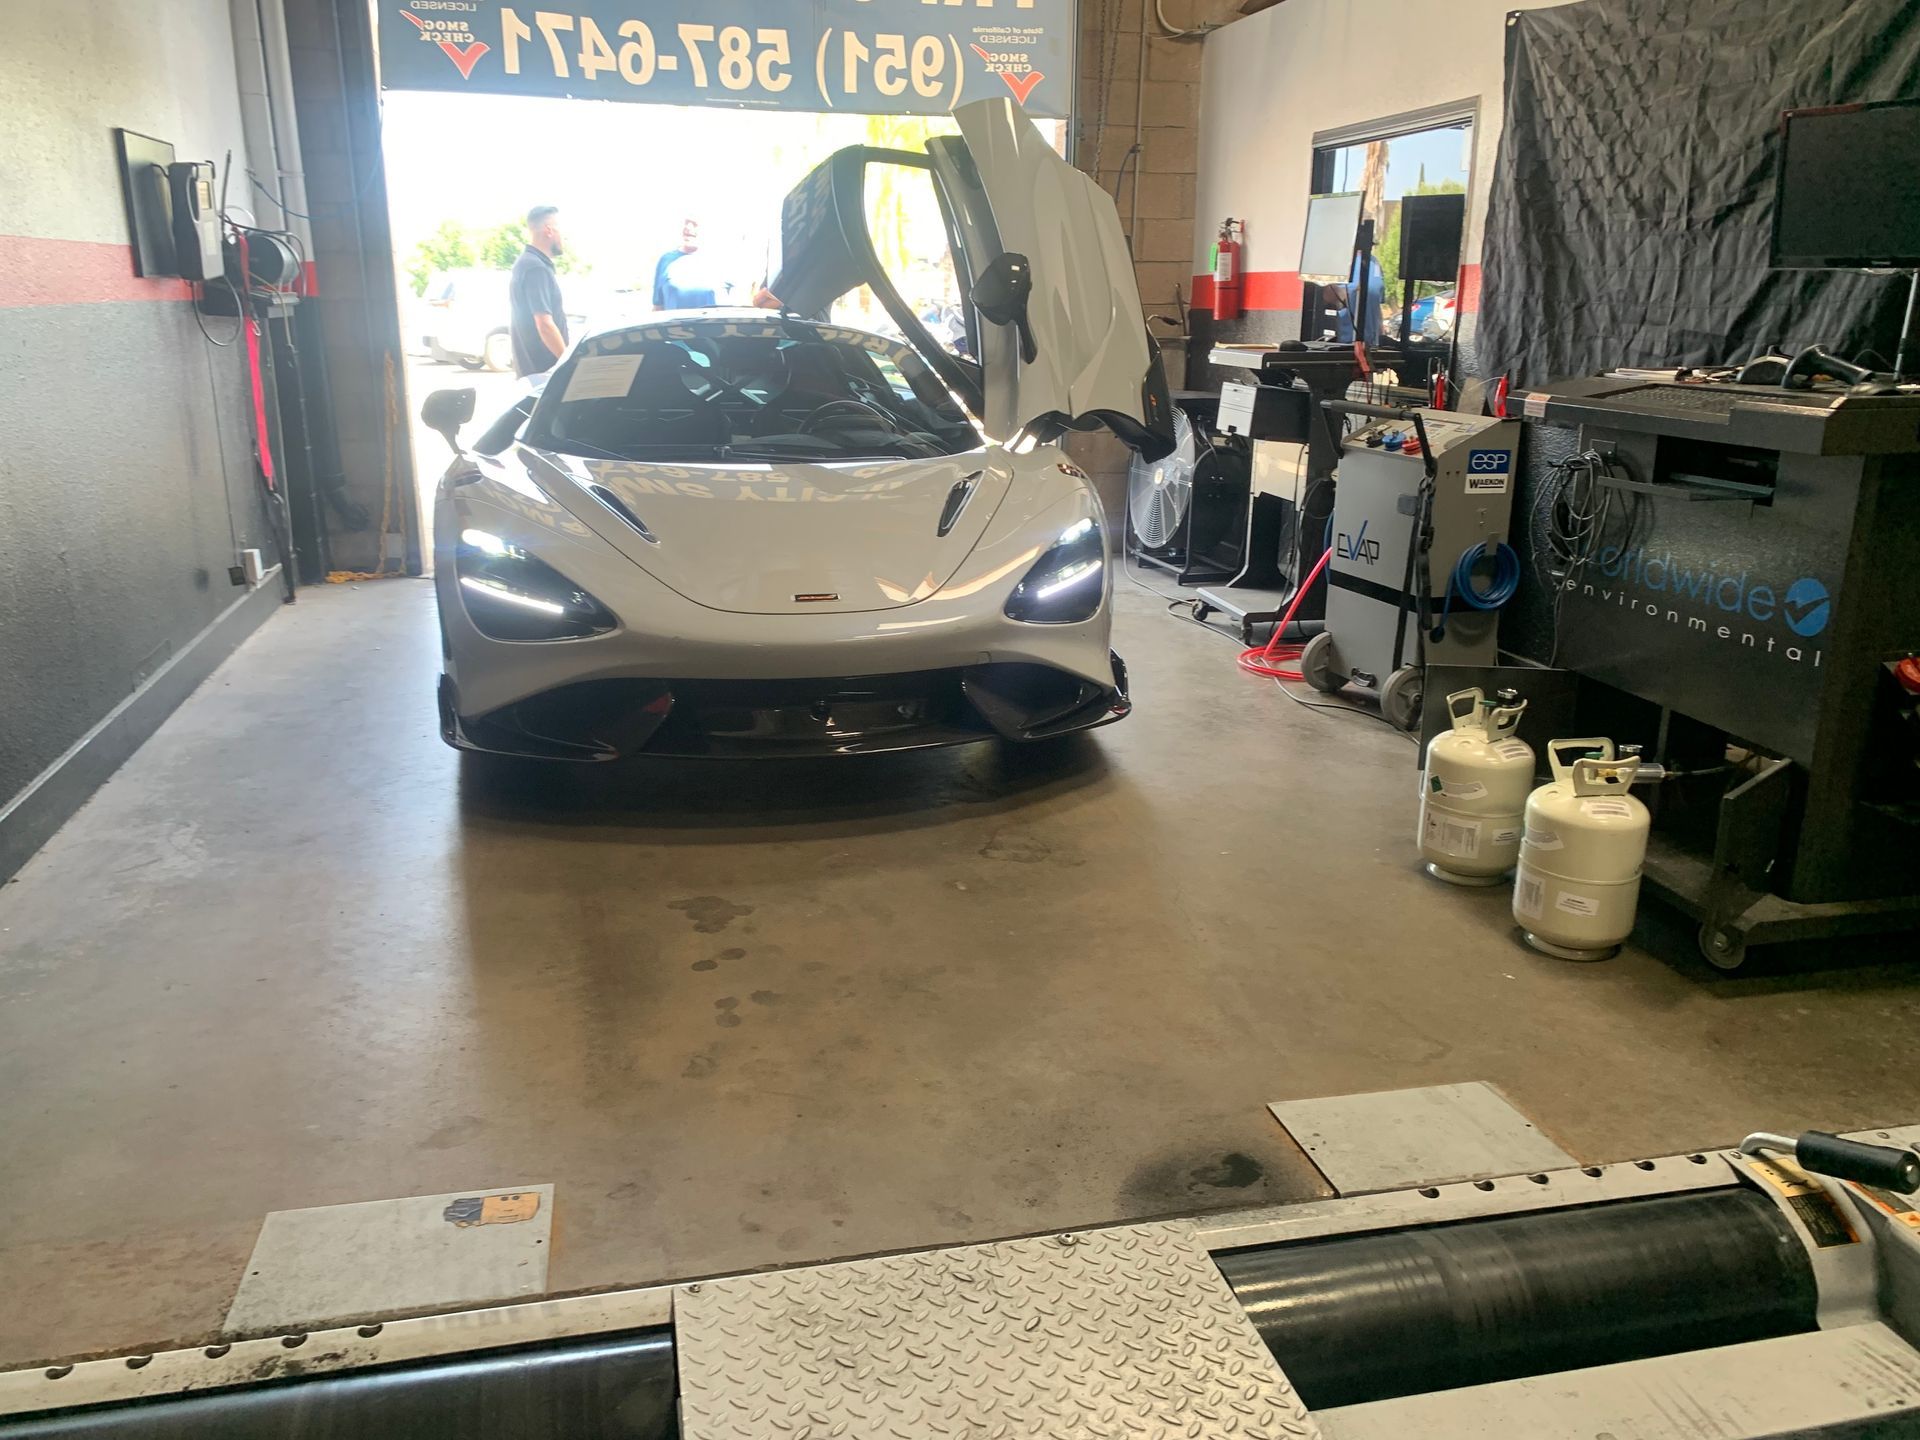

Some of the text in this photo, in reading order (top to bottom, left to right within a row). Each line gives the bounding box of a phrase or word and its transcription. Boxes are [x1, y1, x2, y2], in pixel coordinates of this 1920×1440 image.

[1336, 519, 1380, 566] EVAP
[1580, 542, 1776, 621] orldwide
[1565, 578, 1822, 668] environmental
